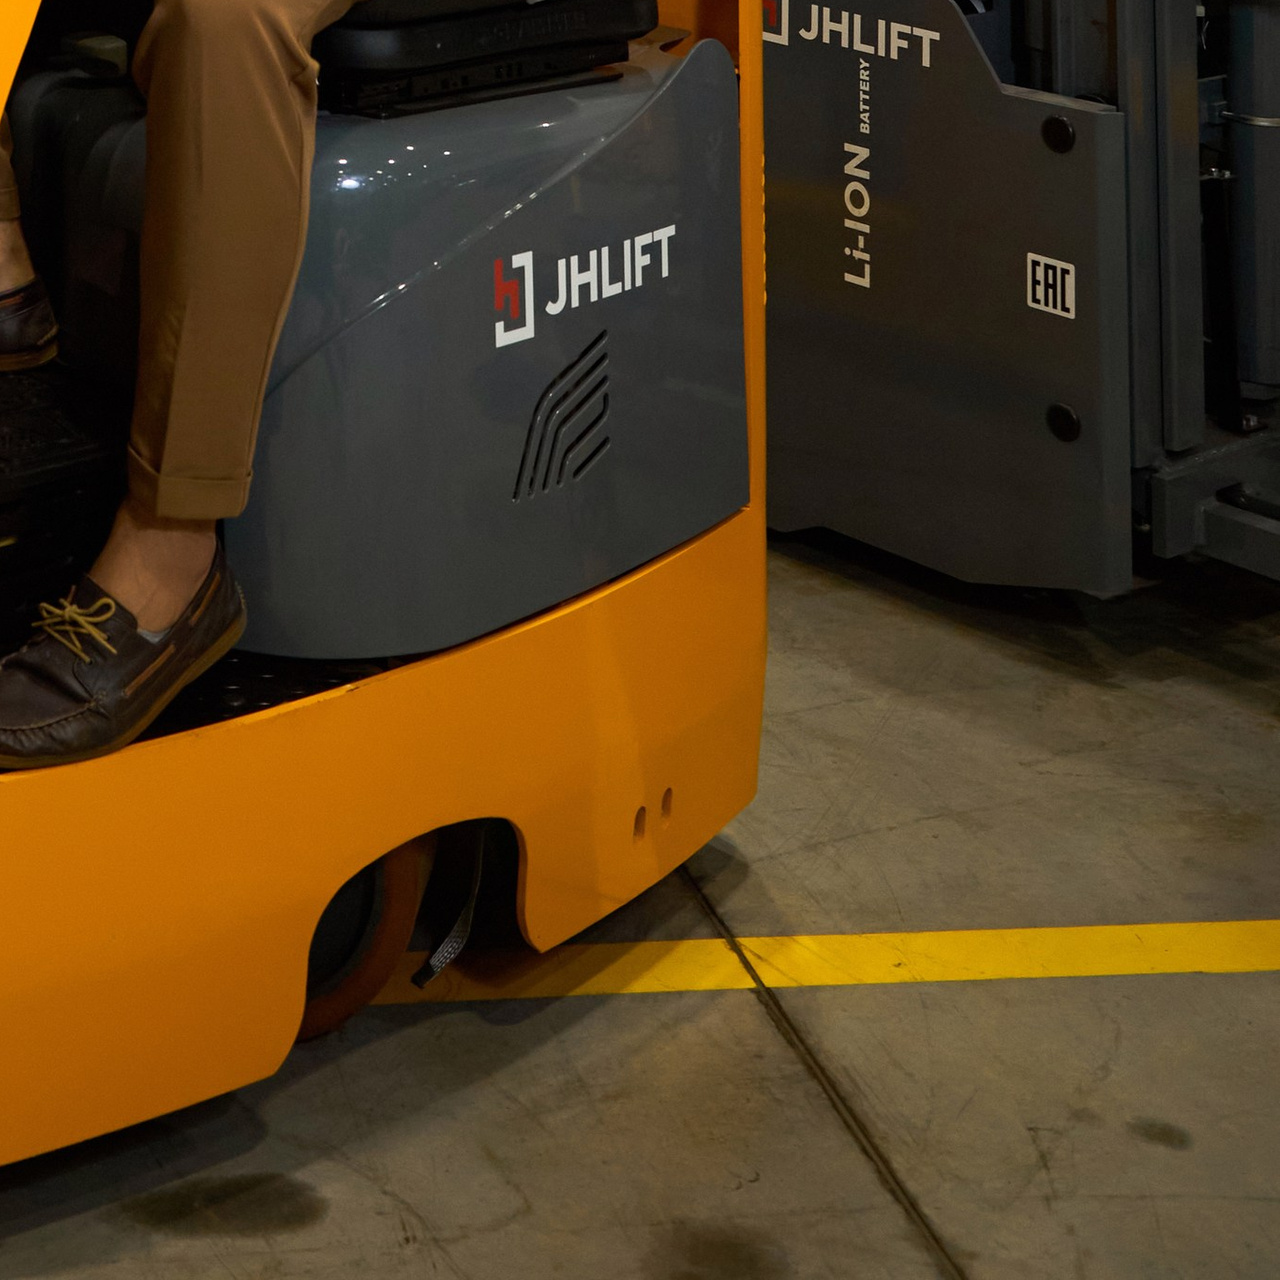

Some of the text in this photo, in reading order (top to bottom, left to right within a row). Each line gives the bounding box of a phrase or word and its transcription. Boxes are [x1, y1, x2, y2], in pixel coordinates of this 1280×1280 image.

[798, 4, 941, 68] JHLIFT
[859, 58, 871, 134] BATTERY
[844, 143, 871, 289] Li-ION
[545, 224, 676, 316] JHLIFT
